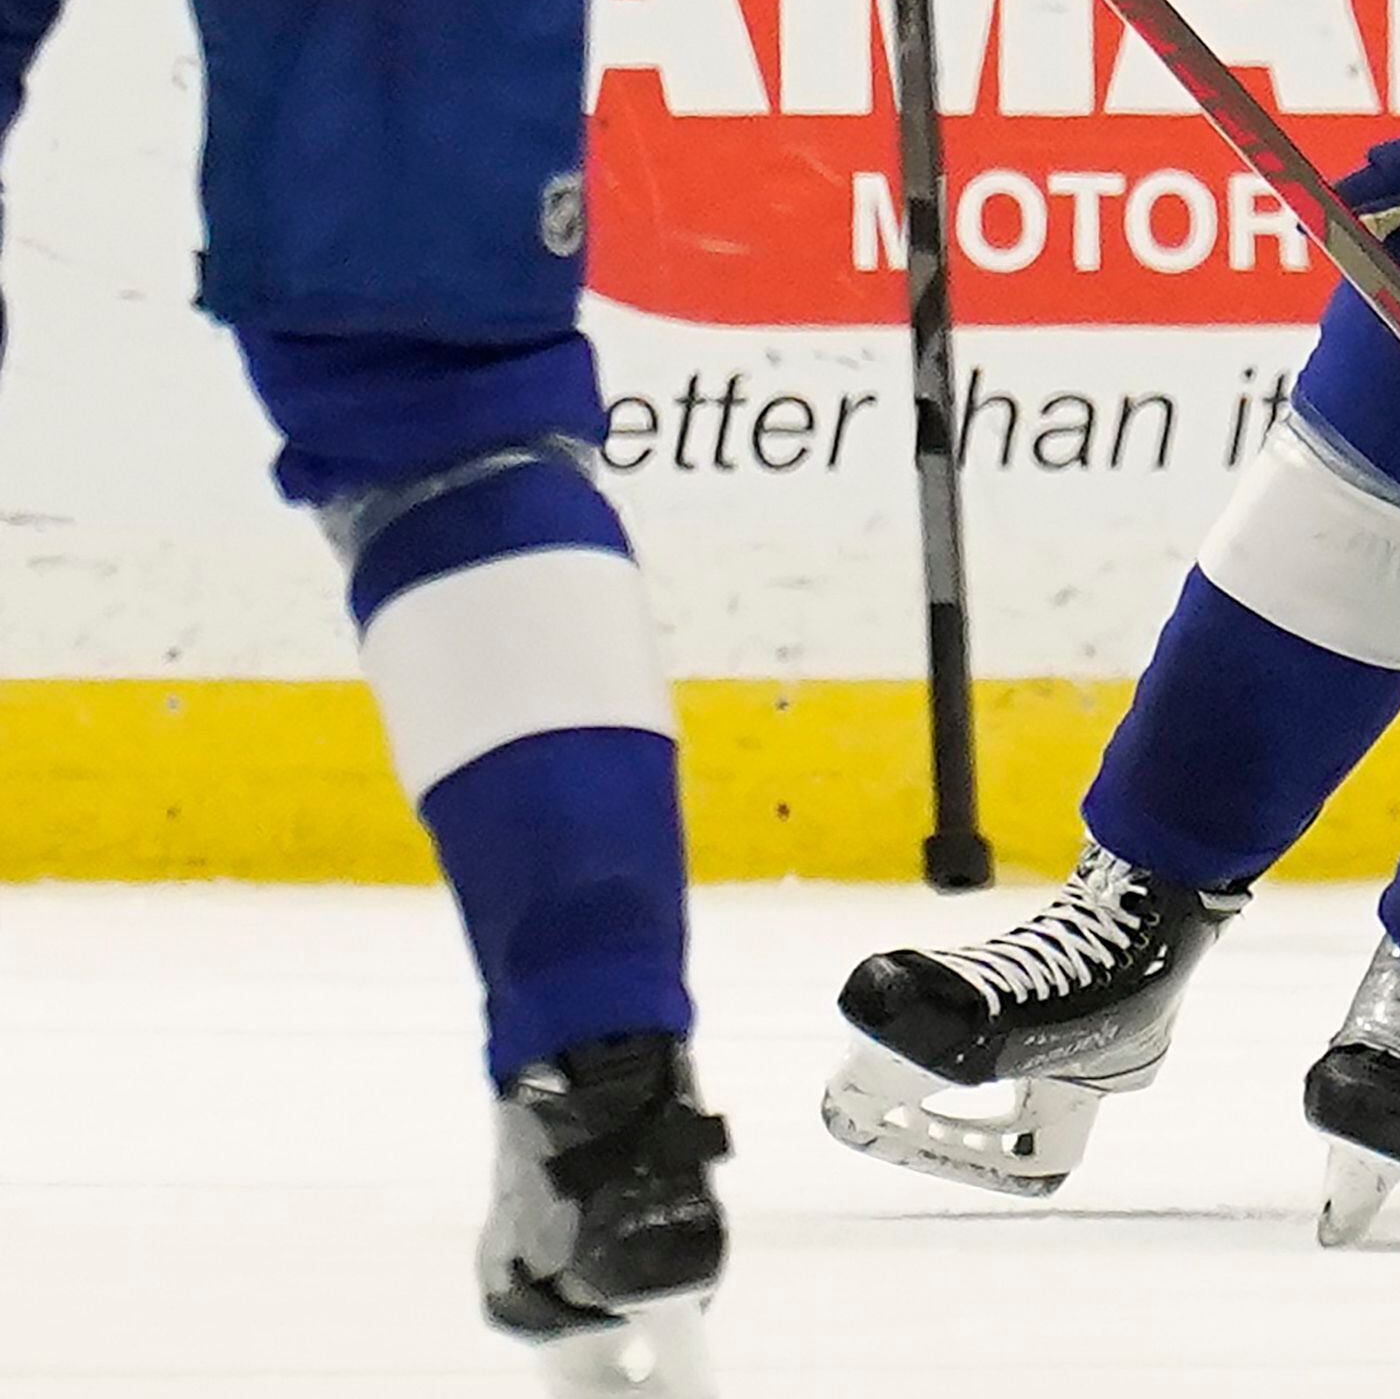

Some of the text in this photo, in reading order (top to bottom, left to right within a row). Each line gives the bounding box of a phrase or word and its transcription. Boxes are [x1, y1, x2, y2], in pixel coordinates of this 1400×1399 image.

[852, 167, 1311, 275] MOTOR
[599, 372, 877, 472] etter
[918, 367, 1174, 473] han
